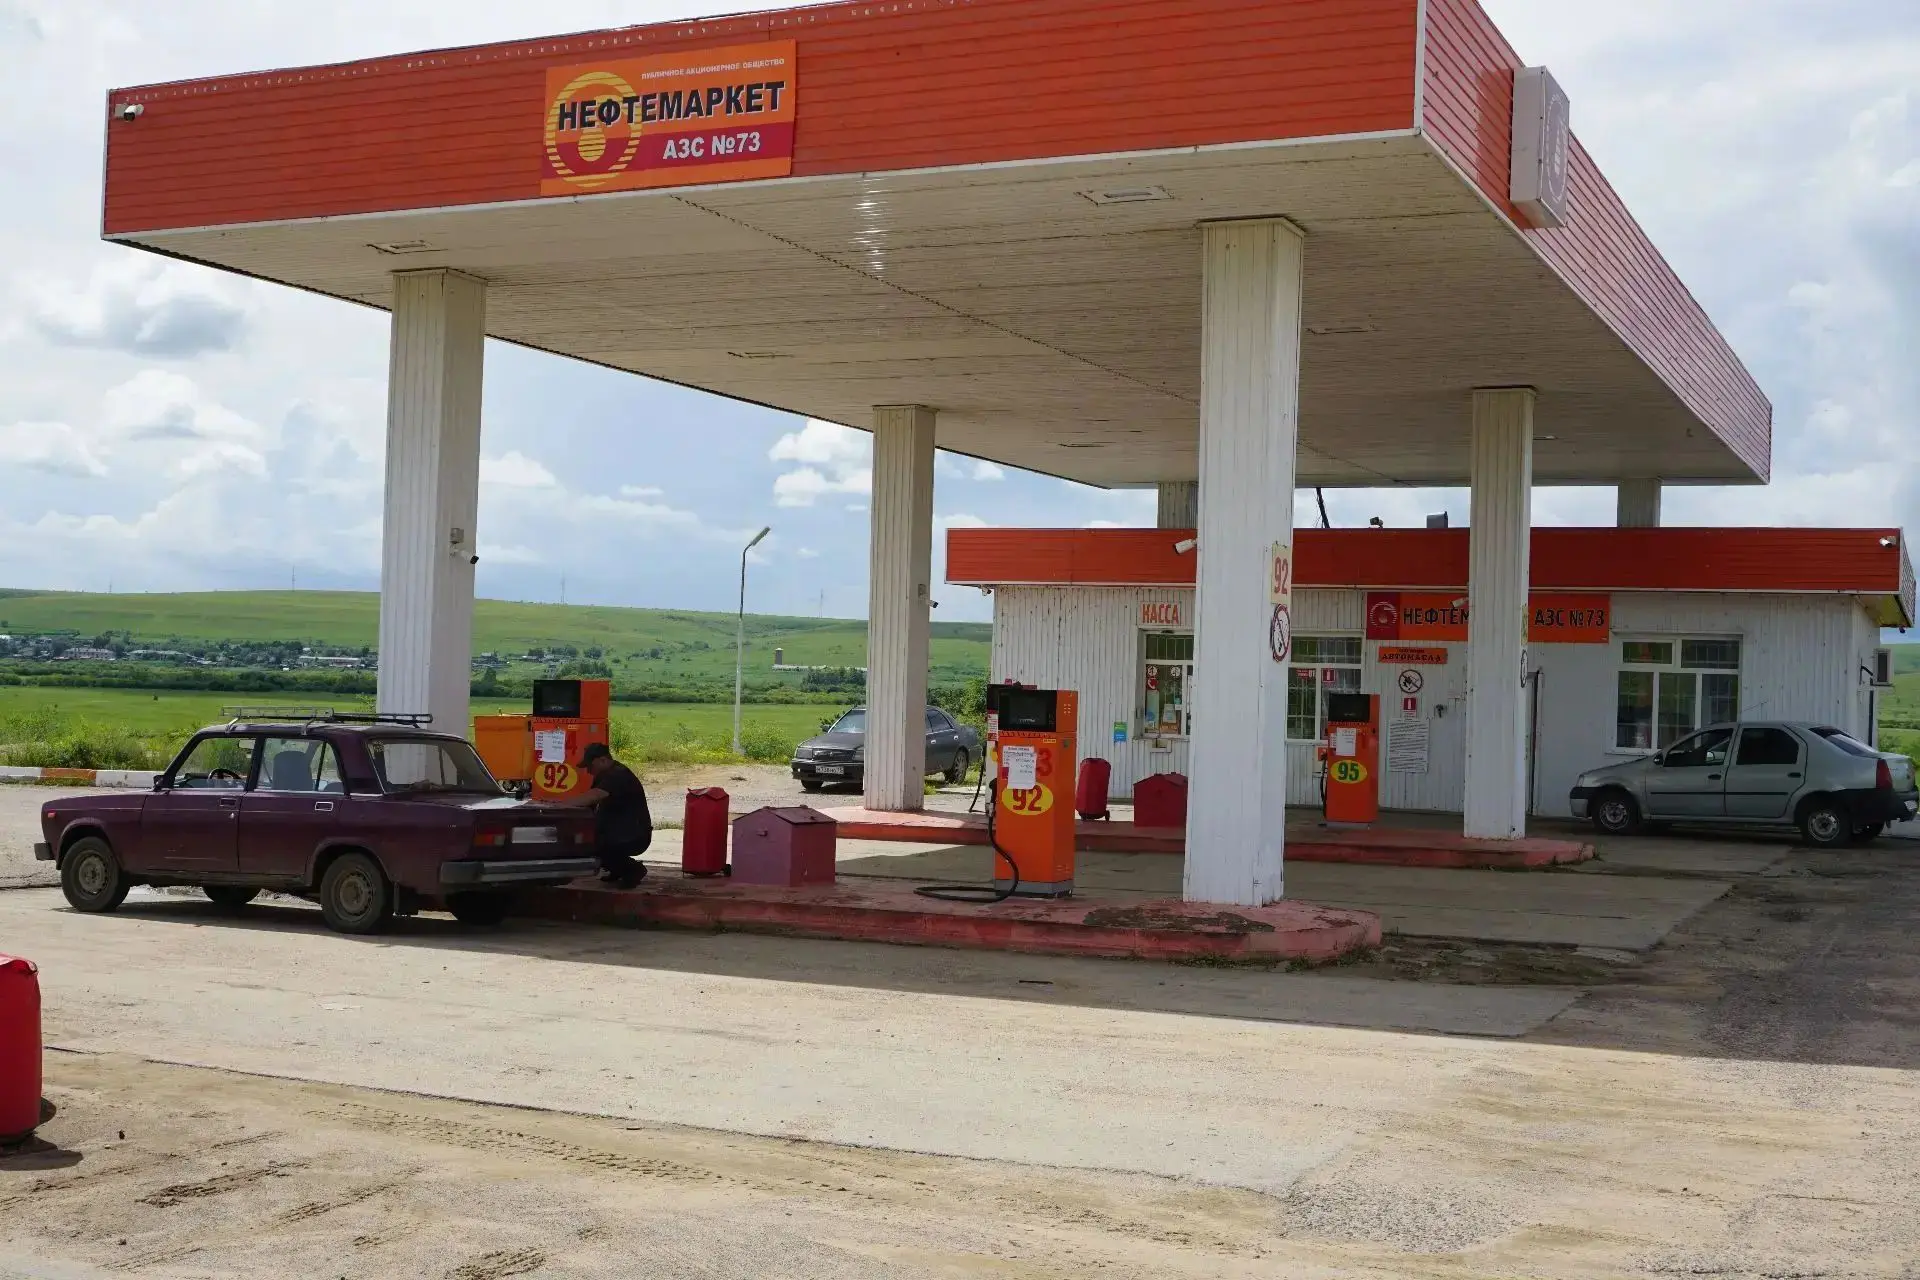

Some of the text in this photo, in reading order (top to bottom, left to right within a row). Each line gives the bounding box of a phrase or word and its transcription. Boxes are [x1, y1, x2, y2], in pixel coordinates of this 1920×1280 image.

[641, 58, 785, 80] ПУБЛИЧНОЕ АКЦИОНЕРНОЕ ОБЩЕСТВО
[558, 81, 785, 131] НЕФТЕМАРКЕТ
[662, 131, 761, 160] АЗС №73
[1274, 556, 1289, 595] 92
[1142, 603, 1179, 624] КАССА
[1534, 609, 1565, 626] АЗС
[1569, 609, 1605, 627] №73
[543, 763, 569, 789] 92
[1337, 761, 1360, 781] 95
[1012, 785, 1043, 811] 92
